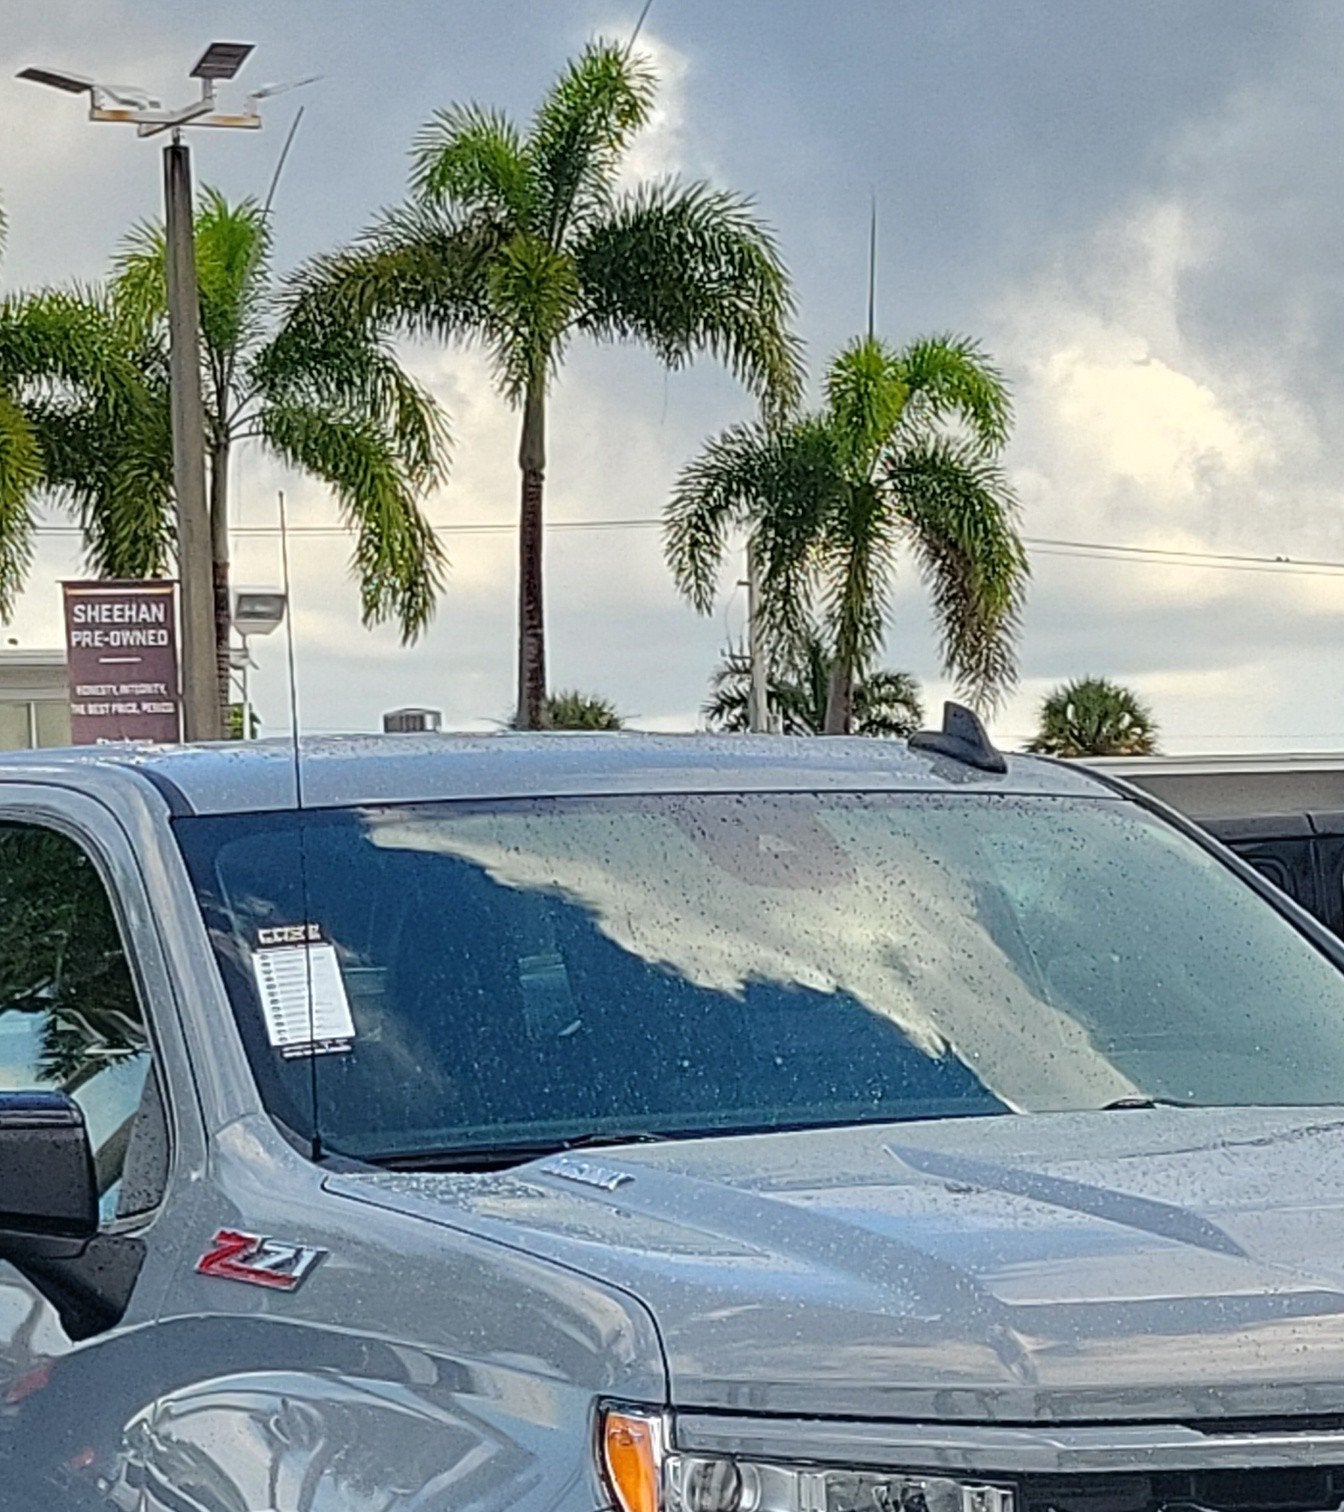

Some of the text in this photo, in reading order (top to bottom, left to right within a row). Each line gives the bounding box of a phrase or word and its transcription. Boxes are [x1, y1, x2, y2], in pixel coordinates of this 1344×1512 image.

[73, 603, 165, 624] SHEEHAN
[70, 629, 169, 648] PRE-OWNED
[194, 1227, 329, 1291] Z71
